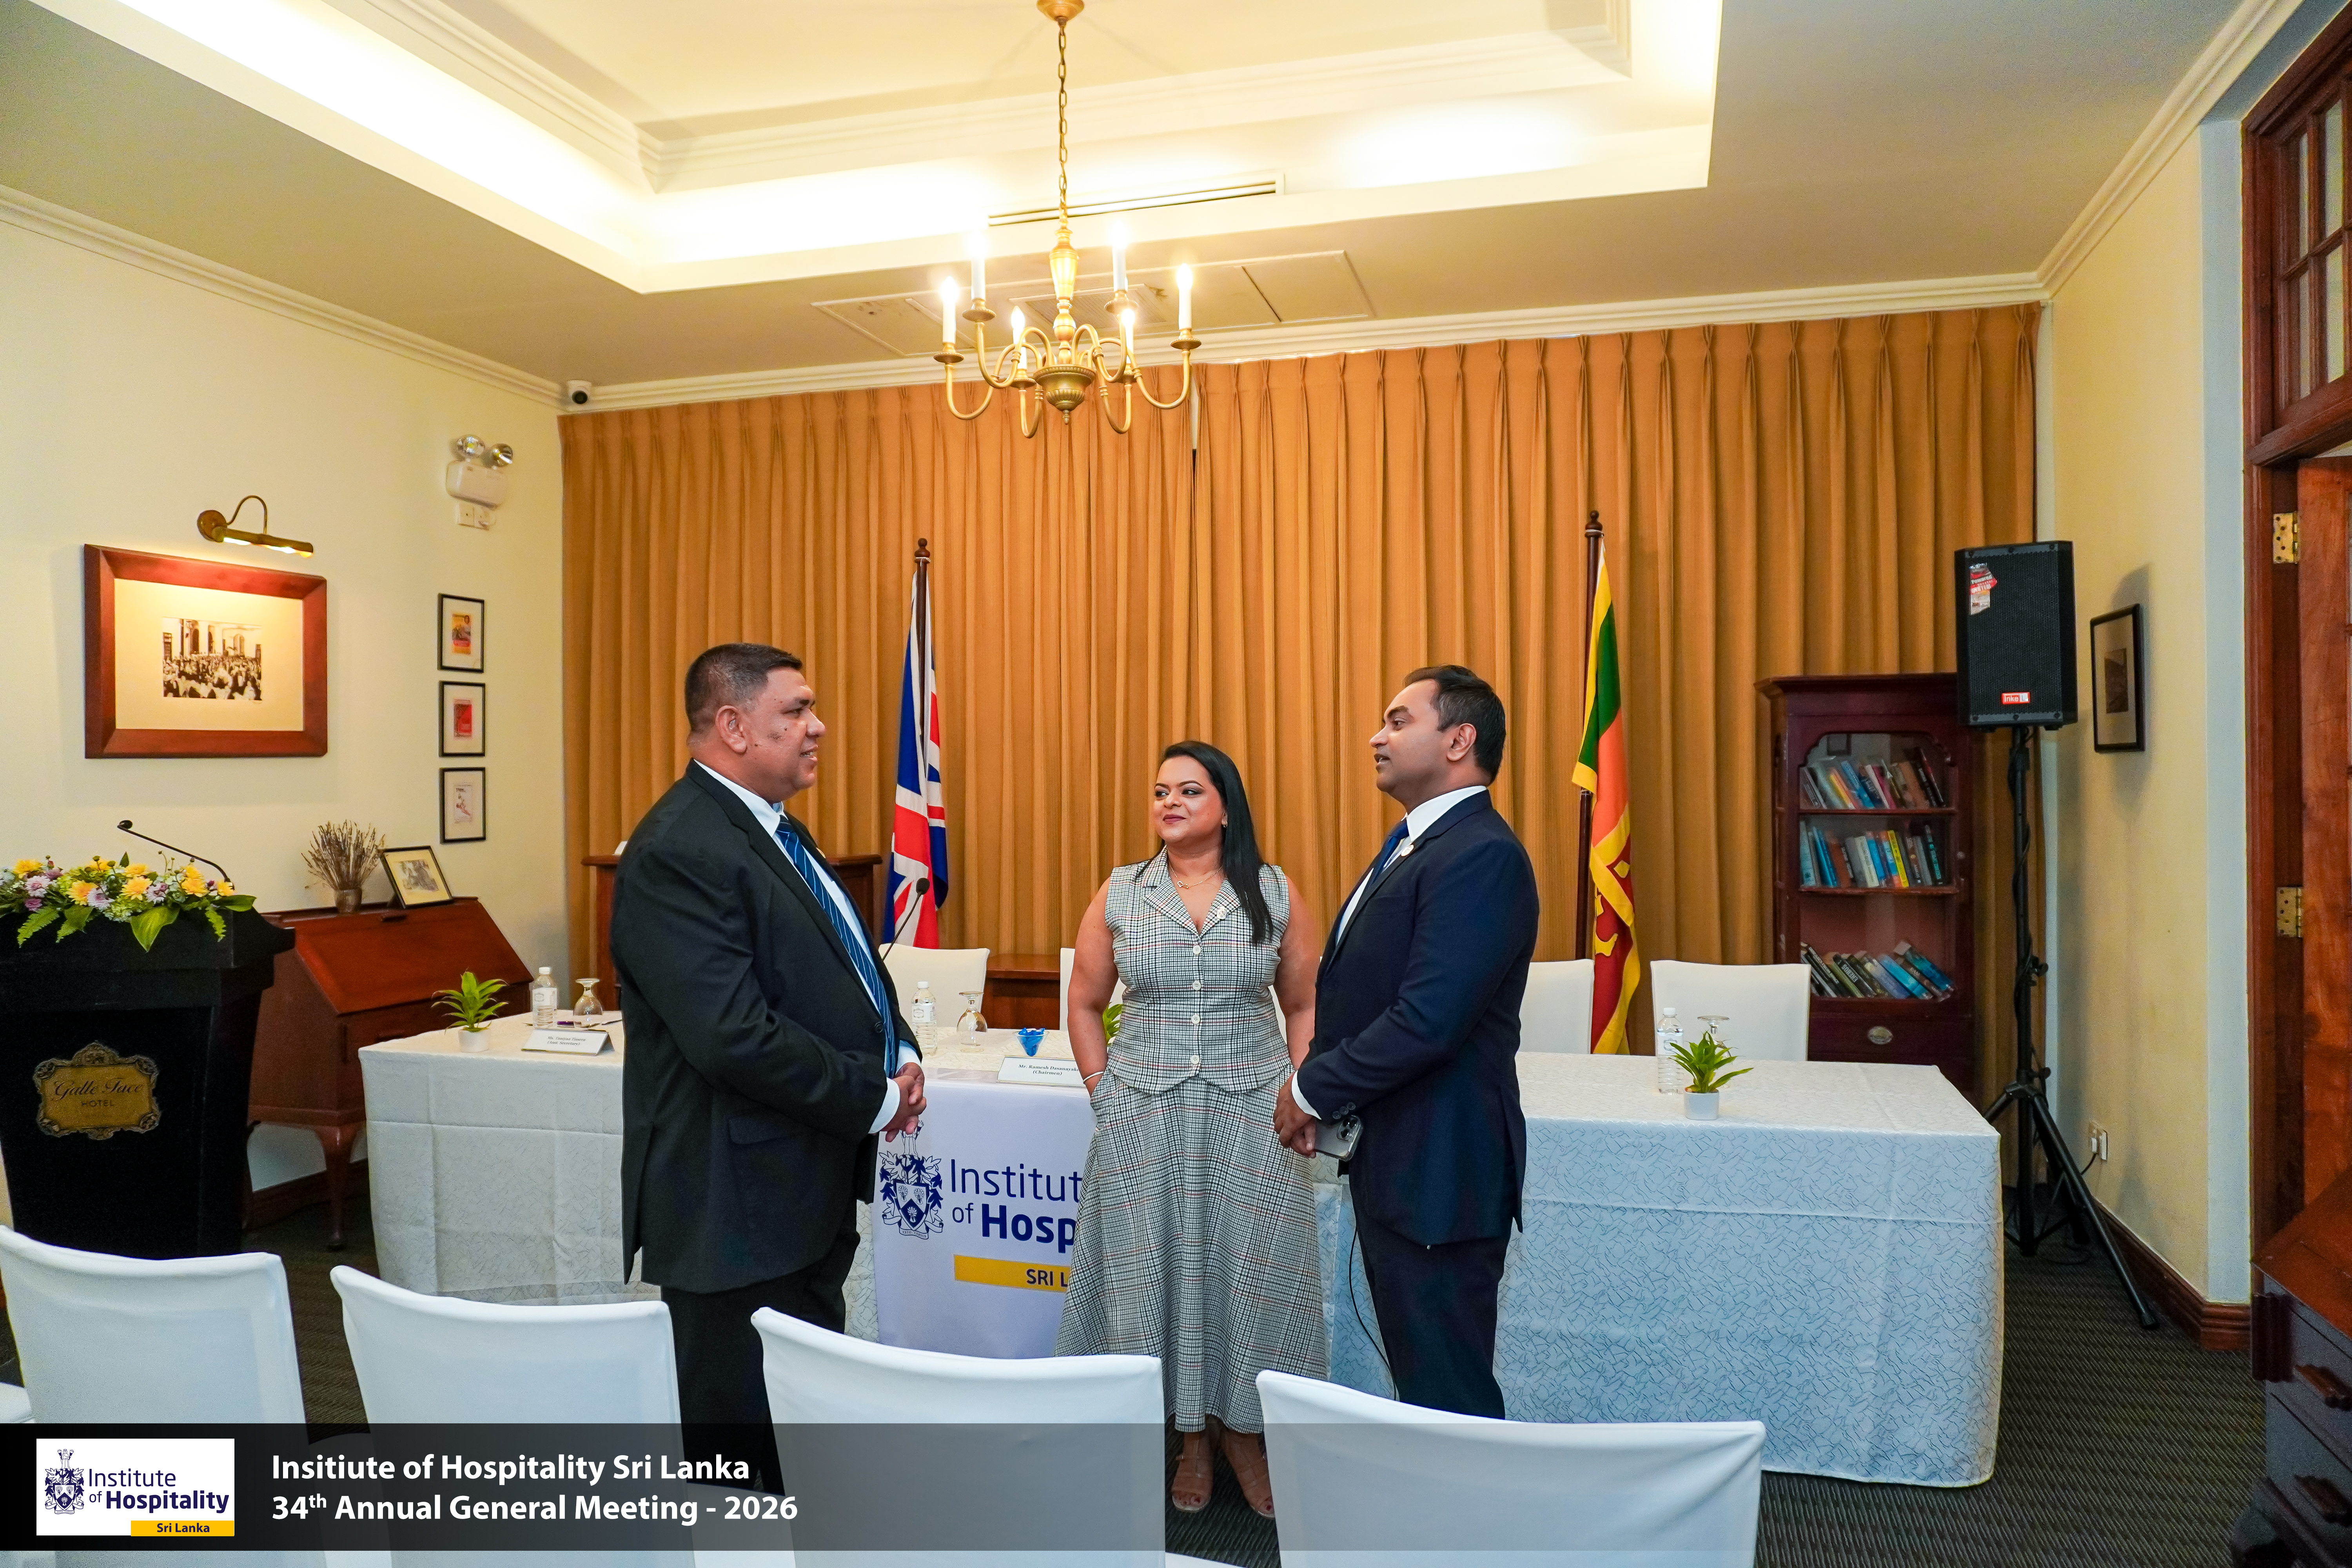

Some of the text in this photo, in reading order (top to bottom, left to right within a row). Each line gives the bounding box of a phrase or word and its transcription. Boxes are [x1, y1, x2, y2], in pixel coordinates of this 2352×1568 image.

[951, 1159, 1082, 1203] Institut
[952, 1202, 1076, 1254] of Hosp
[1026, 1269, 1068, 1287] SRI L
